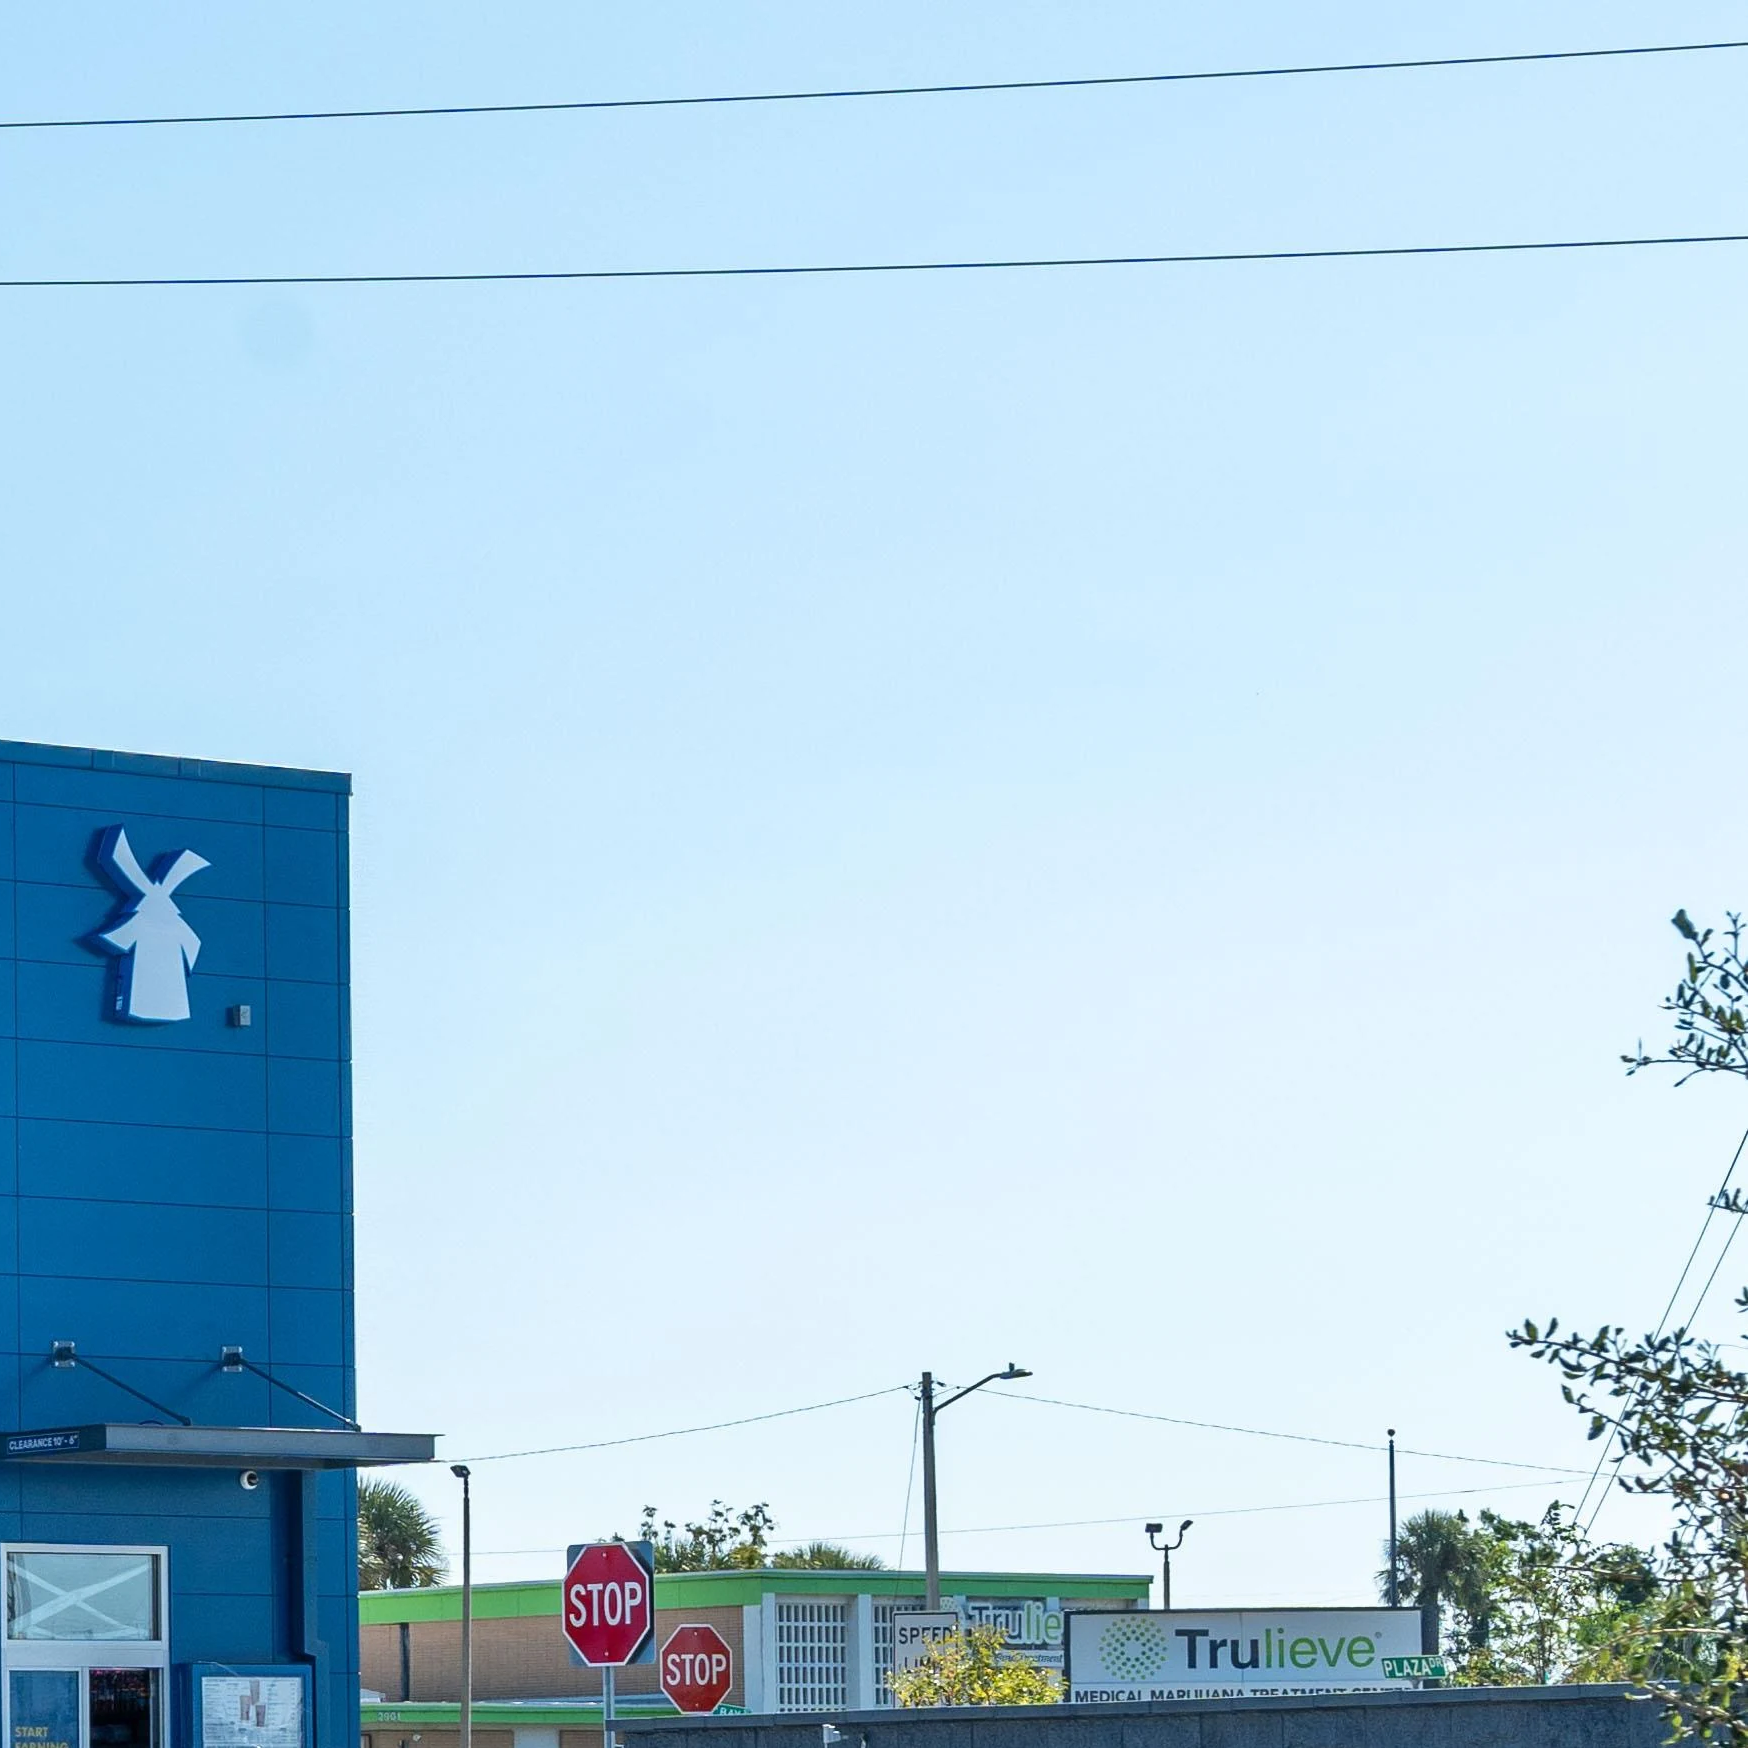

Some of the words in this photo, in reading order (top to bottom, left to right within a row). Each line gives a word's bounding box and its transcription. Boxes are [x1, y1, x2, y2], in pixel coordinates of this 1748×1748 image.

[9, 1438, 53, 1450] CLEARANCE
[569, 1581, 642, 1628] STOP
[1174, 1627, 1375, 1670] Trulieve
[666, 1653, 727, 1686] STOP
[1384, 1659, 1432, 1677] PLAZA
[1430, 1658, 1443, 1669] DR
[1075, 1690, 1142, 1703] MEDICAL
[15, 1726, 49, 1738] START
